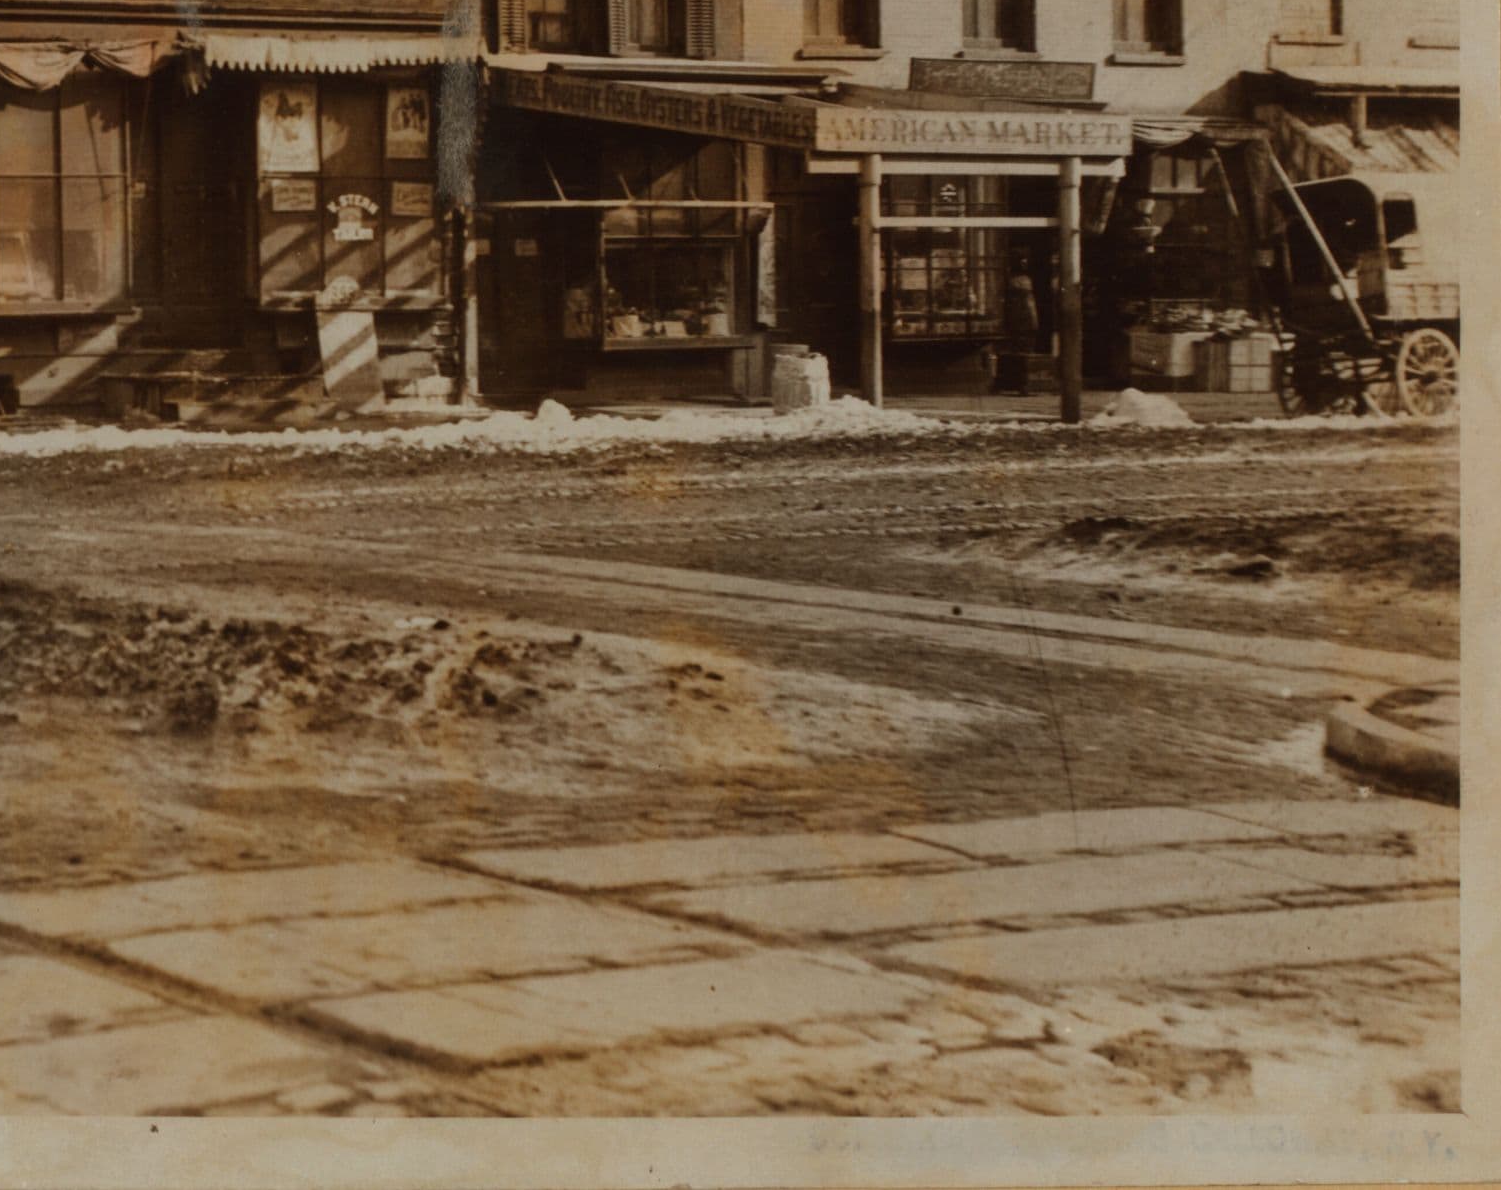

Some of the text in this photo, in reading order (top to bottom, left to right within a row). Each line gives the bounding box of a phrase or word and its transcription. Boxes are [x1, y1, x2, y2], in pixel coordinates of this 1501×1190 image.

[606, 83, 636, 115] FISH
[640, 88, 703, 125] OYSTERS
[823, 114, 976, 144] AMERICAN
